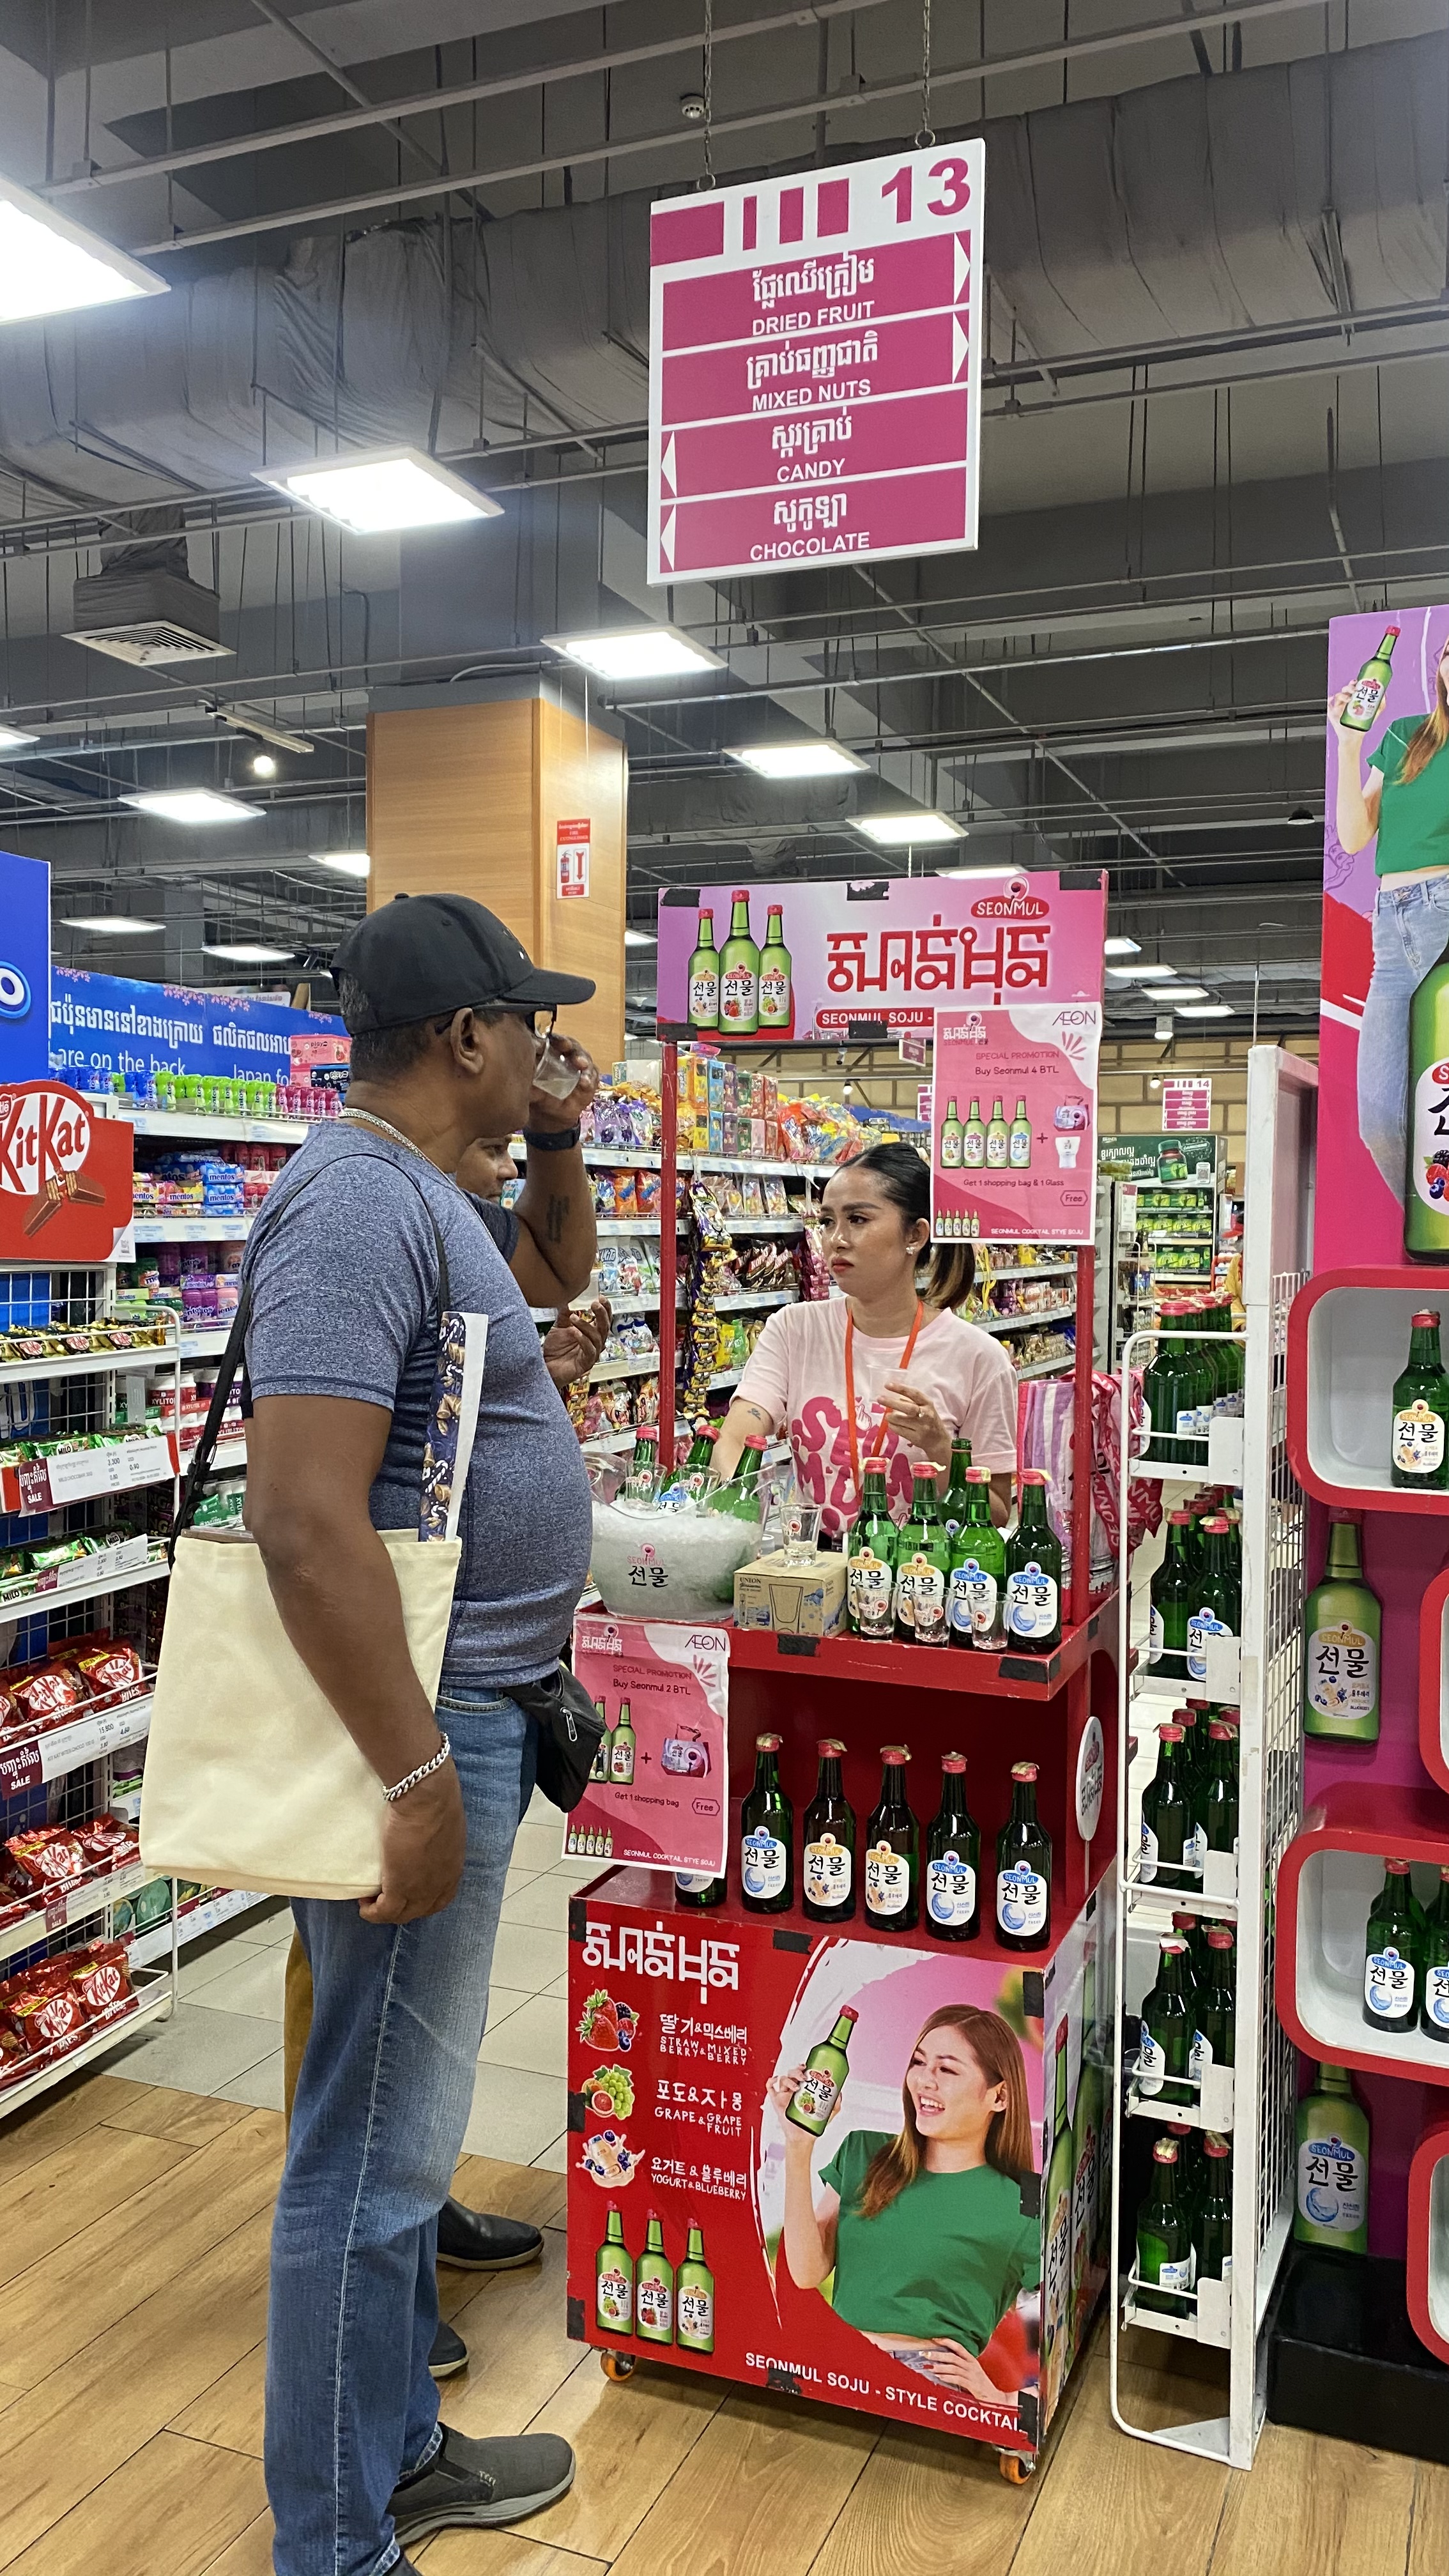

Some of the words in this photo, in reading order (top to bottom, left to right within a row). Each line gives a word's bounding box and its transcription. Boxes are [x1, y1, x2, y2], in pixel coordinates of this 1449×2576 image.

[882, 157, 970, 224] 13
[753, 311, 811, 337] DRIED
[817, 301, 875, 323] FRUIT
[752, 387, 812, 411] MIXED
[818, 379, 871, 402] NUTS
[777, 459, 846, 483] CANDY
[750, 532, 870, 562] CHOCOLATE
[976, 901, 1043, 916] SEONMUL
[889, 1011, 924, 1023] SOJU
[90, 1052, 112, 1069] on
[118, 1050, 145, 1073] the
[150, 1054, 186, 1077] back
[975, 1067, 991, 1076] Buy
[994, 1066, 1029, 1075] Seonmul
[1040, 1066, 1059, 1074] BTL
[1197, 1080, 1209, 1088] 14
[0, 1094, 86, 1193] KitKat
[984, 1179, 1016, 1188] shopping
[1018, 1179, 1031, 1188] bag
[57, 1445, 72, 1455] MILO
[27, 1492, 42, 1504] SALE
[107, 1535, 119, 1545] MILO
[954, 1571, 985, 1581] SEONMUL
[1015, 1576, 1046, 1584] SEONMUL
[3, 1589, 20, 1603] MILO
[1191, 1620, 1219, 1630] SEONMUL
[1322, 1633, 1363, 1646] SEONMUL
[613, 1664, 645, 1675] SPECIAL
[647, 1668, 692, 1680] PROMOTION
[613, 1678, 628, 1689] Buy
[631, 1681, 664, 1692] Seonmul
[673, 1685, 691, 1695] BTL
[11, 1775, 31, 1790] SALE
[615, 1792, 627, 1800] Get
[634, 1794, 664, 1805] shopping
[666, 1798, 679, 1807] bag
[696, 1802, 714, 1811] Free
[746, 1838, 775, 1848] SEONMUL
[624, 1849, 652, 1859] SEONMUL
[653, 1853, 682, 1863] COCKTAIL
[811, 1846, 840, 1855] SEONMUL
[934, 1864, 965, 1873] SEONMUL
[1004, 1874, 1036, 1883] SEONMUL
[1373, 1958, 1404, 1969] SEONMUL
[92, 1968, 119, 2005] KitKat
[661, 2035, 699, 2049] STRAW
[660, 2044, 698, 2058] BERRY
[700, 2047, 706, 2055] &
[707, 2043, 747, 2057] MIXED
[707, 2052, 746, 2066] BERRY
[655, 2106, 696, 2123] GRAPE
[698, 2116, 706, 2124] &
[707, 2113, 742, 2127] GRAPE
[707, 2122, 742, 2137] FRUIT
[1311, 2145, 1352, 2159] SEONMUL
[651, 2157, 686, 2175] 요거트
[689, 2165, 698, 2177] &
[702, 2164, 746, 2190] 블루베리
[827, 2372, 870, 2395] SOJU
[885, 2387, 938, 2412] STYLE
[943, 2400, 1027, 2434] COCKTAI
